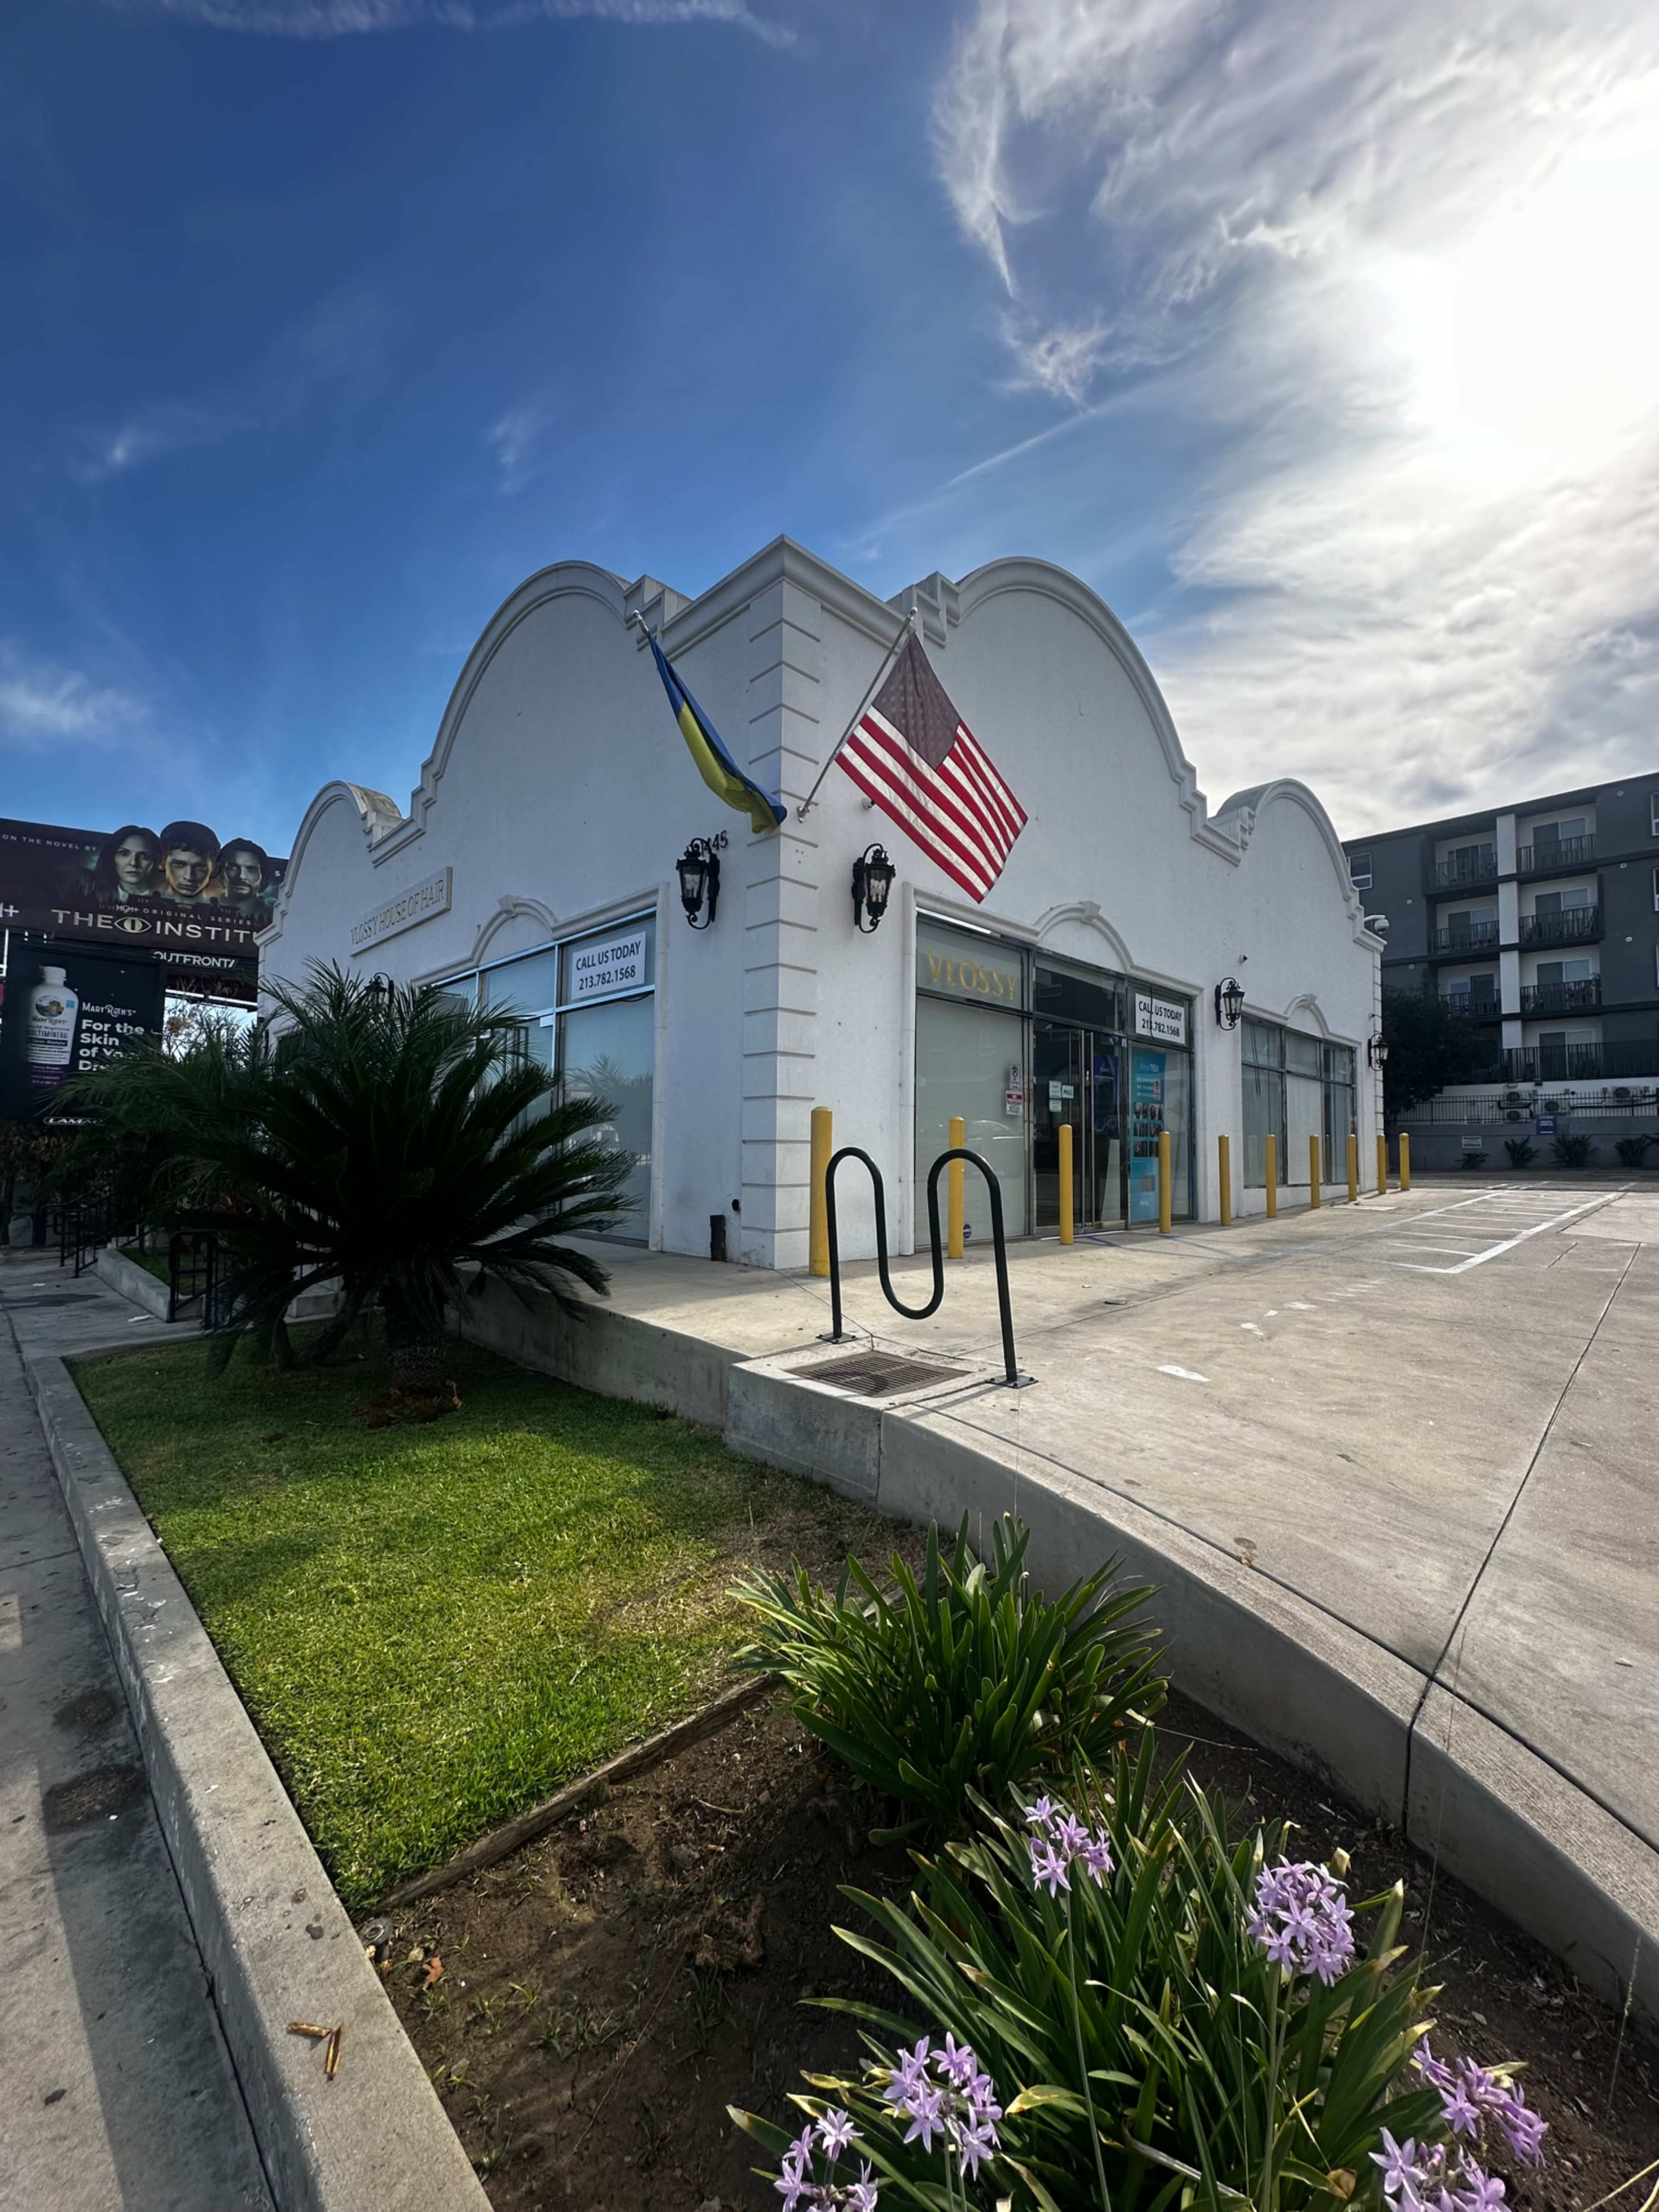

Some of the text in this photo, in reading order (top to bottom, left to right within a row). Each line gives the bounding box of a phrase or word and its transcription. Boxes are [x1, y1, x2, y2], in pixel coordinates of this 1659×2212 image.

[46, 840, 79, 849] NOVEL
[51, 909, 114, 928] THE
[143, 908, 202, 920] ORIGINAL
[211, 915, 251, 925] SERIES
[351, 879, 444, 946] VLOSSY HOUSE OF HAIR
[576, 941, 641, 970] CALL US TODAY
[579, 965, 636, 991] 213.782.1568
[927, 947, 1017, 1000] VLOSSY
[1138, 1001, 1182, 1022] CALL US TODAY
[82, 1019, 111, 1032] For
[115, 1022, 145, 1034] the
[80, 1033, 119, 1046] Skin
[79, 1047, 99, 1057] of
